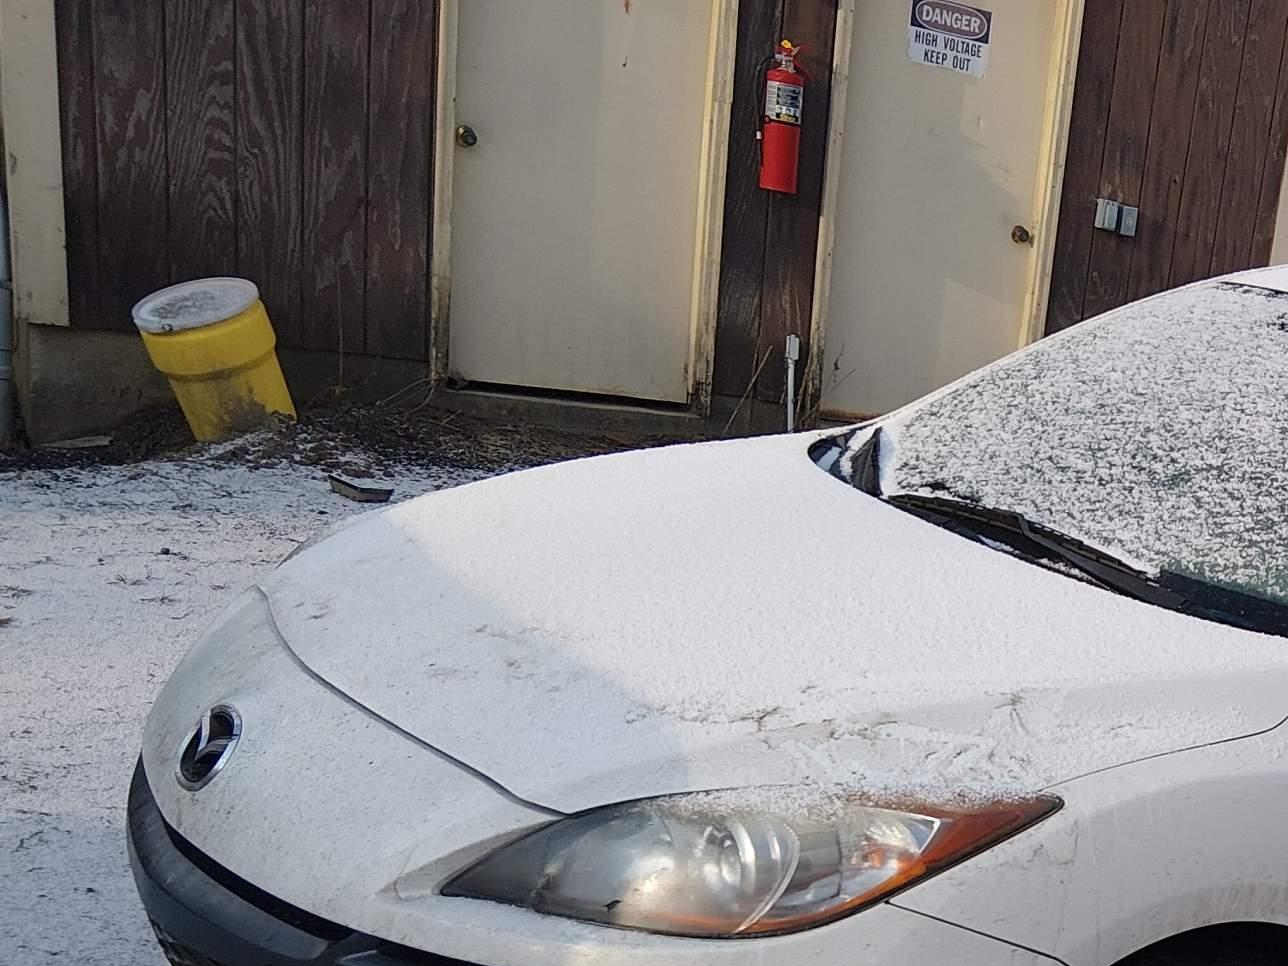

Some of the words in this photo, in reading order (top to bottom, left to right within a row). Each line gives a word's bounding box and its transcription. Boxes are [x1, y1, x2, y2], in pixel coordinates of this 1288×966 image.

[922, 5, 980, 32] DANGER
[914, 29, 938, 48] HIGH
[943, 36, 983, 58] VOLTAGE
[923, 48, 948, 66] KEEP
[952, 55, 971, 72] OUT
